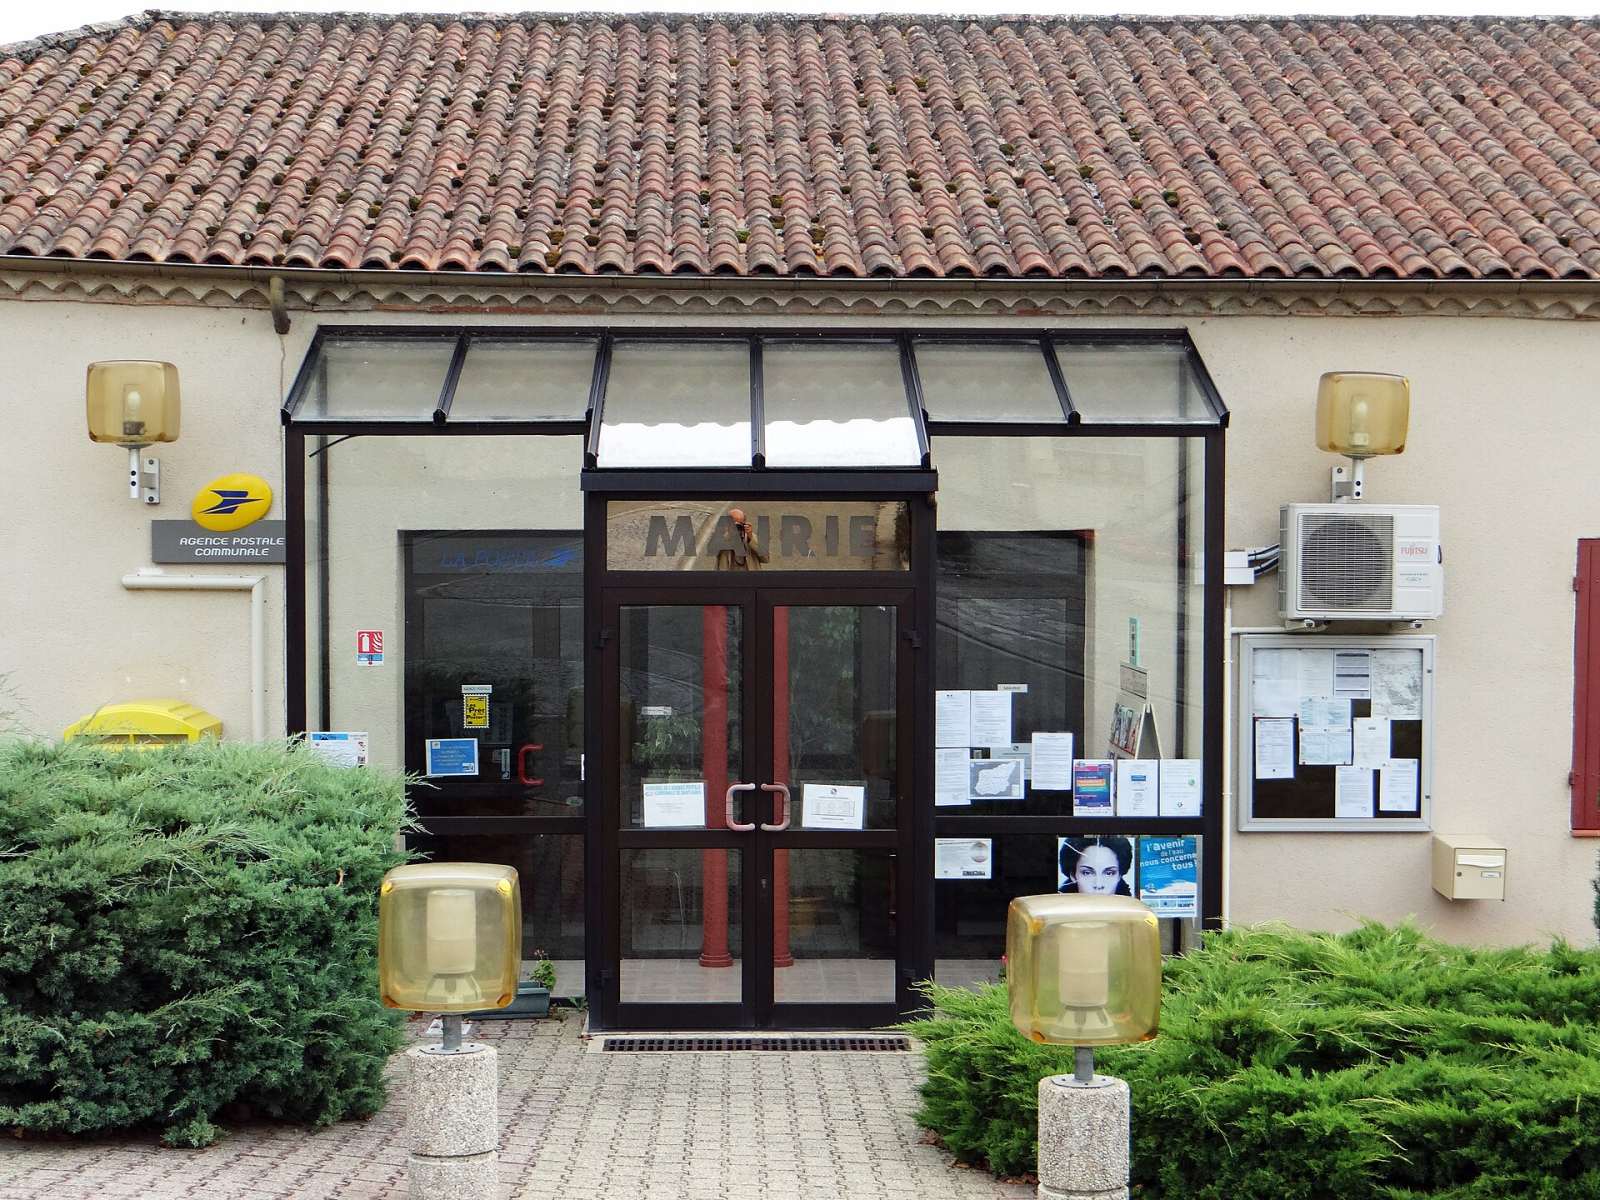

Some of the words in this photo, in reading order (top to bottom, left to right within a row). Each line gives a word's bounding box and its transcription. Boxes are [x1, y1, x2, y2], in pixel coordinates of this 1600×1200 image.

[644, 515, 877, 557] MAIRIE
[180, 537, 229, 546] AGENCE
[232, 537, 285, 546] POSTALE
[194, 547, 269, 556] COMMUNALE
